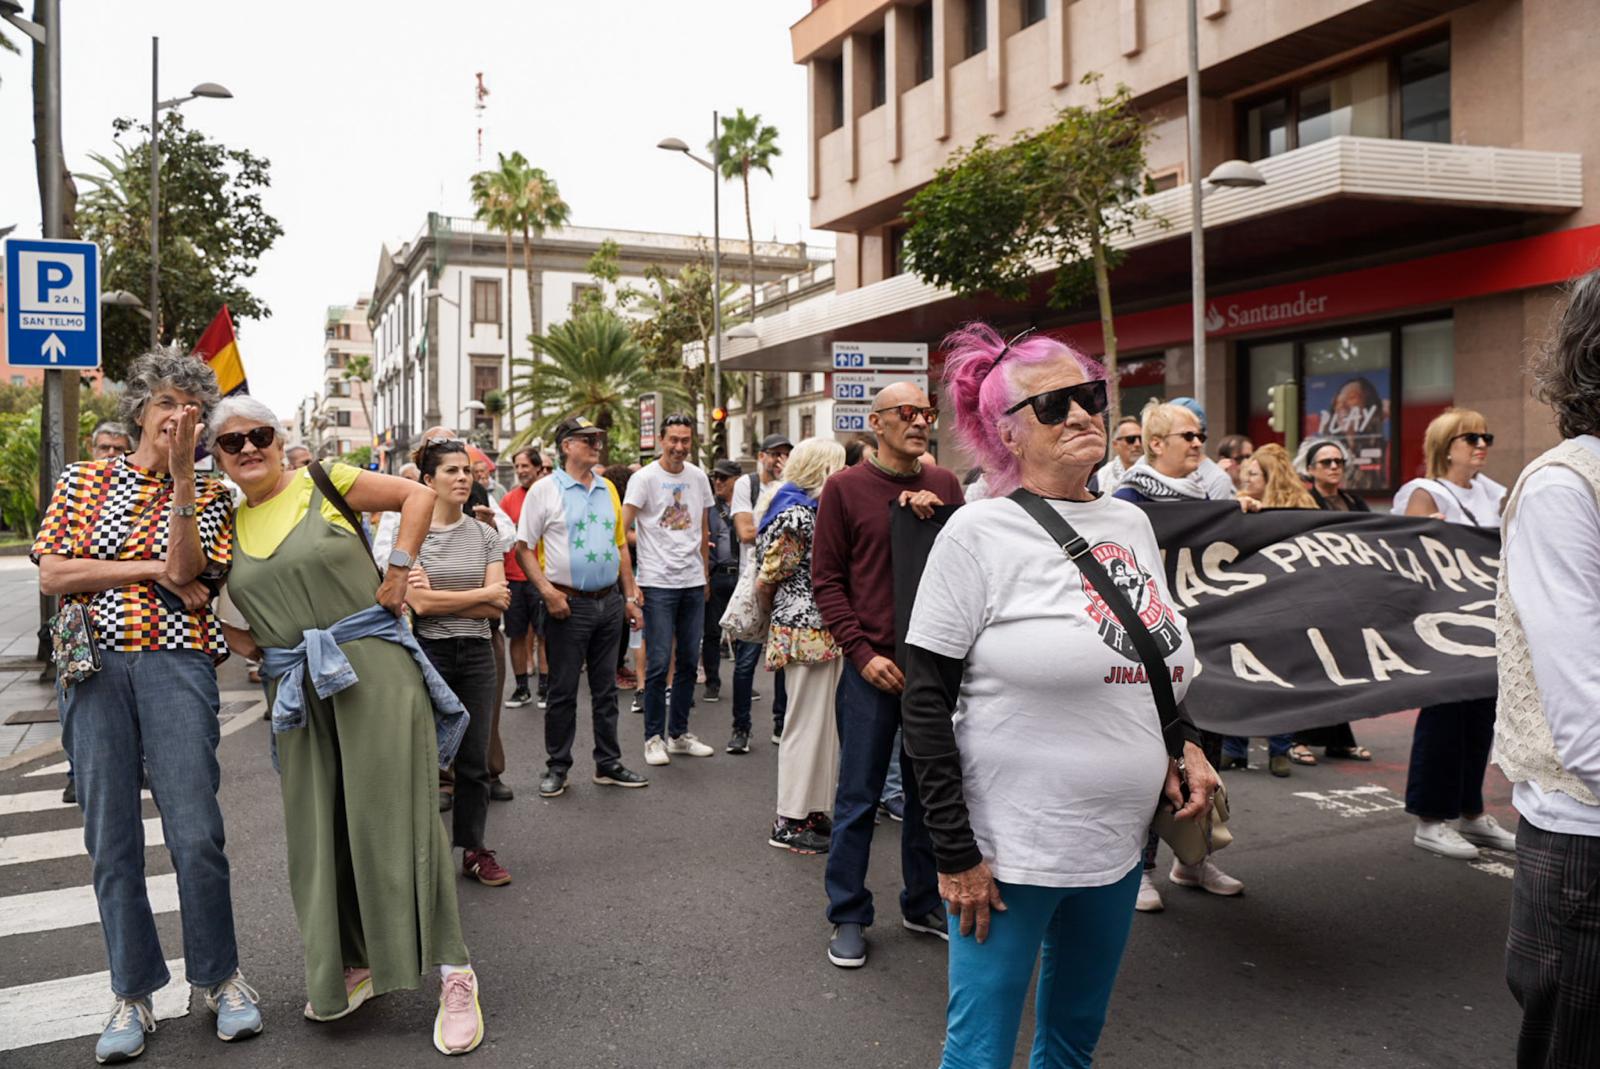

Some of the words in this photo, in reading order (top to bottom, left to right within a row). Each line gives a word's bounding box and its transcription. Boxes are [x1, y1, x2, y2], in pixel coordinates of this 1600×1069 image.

[37, 260, 73, 303] P
[54, 295, 69, 304] 24
[1227, 290, 1328, 328] Santander
[22, 316, 45, 326] SAN
[47, 317, 83, 327] TELMO
[1318, 404, 1377, 435] PLAY
[1160, 541, 1267, 611] AS
[1259, 532, 1392, 573] PARA
[1378, 538, 1436, 591] LA
[1104, 663, 1184, 684] JINÁR
[1306, 627, 1432, 687] LA
